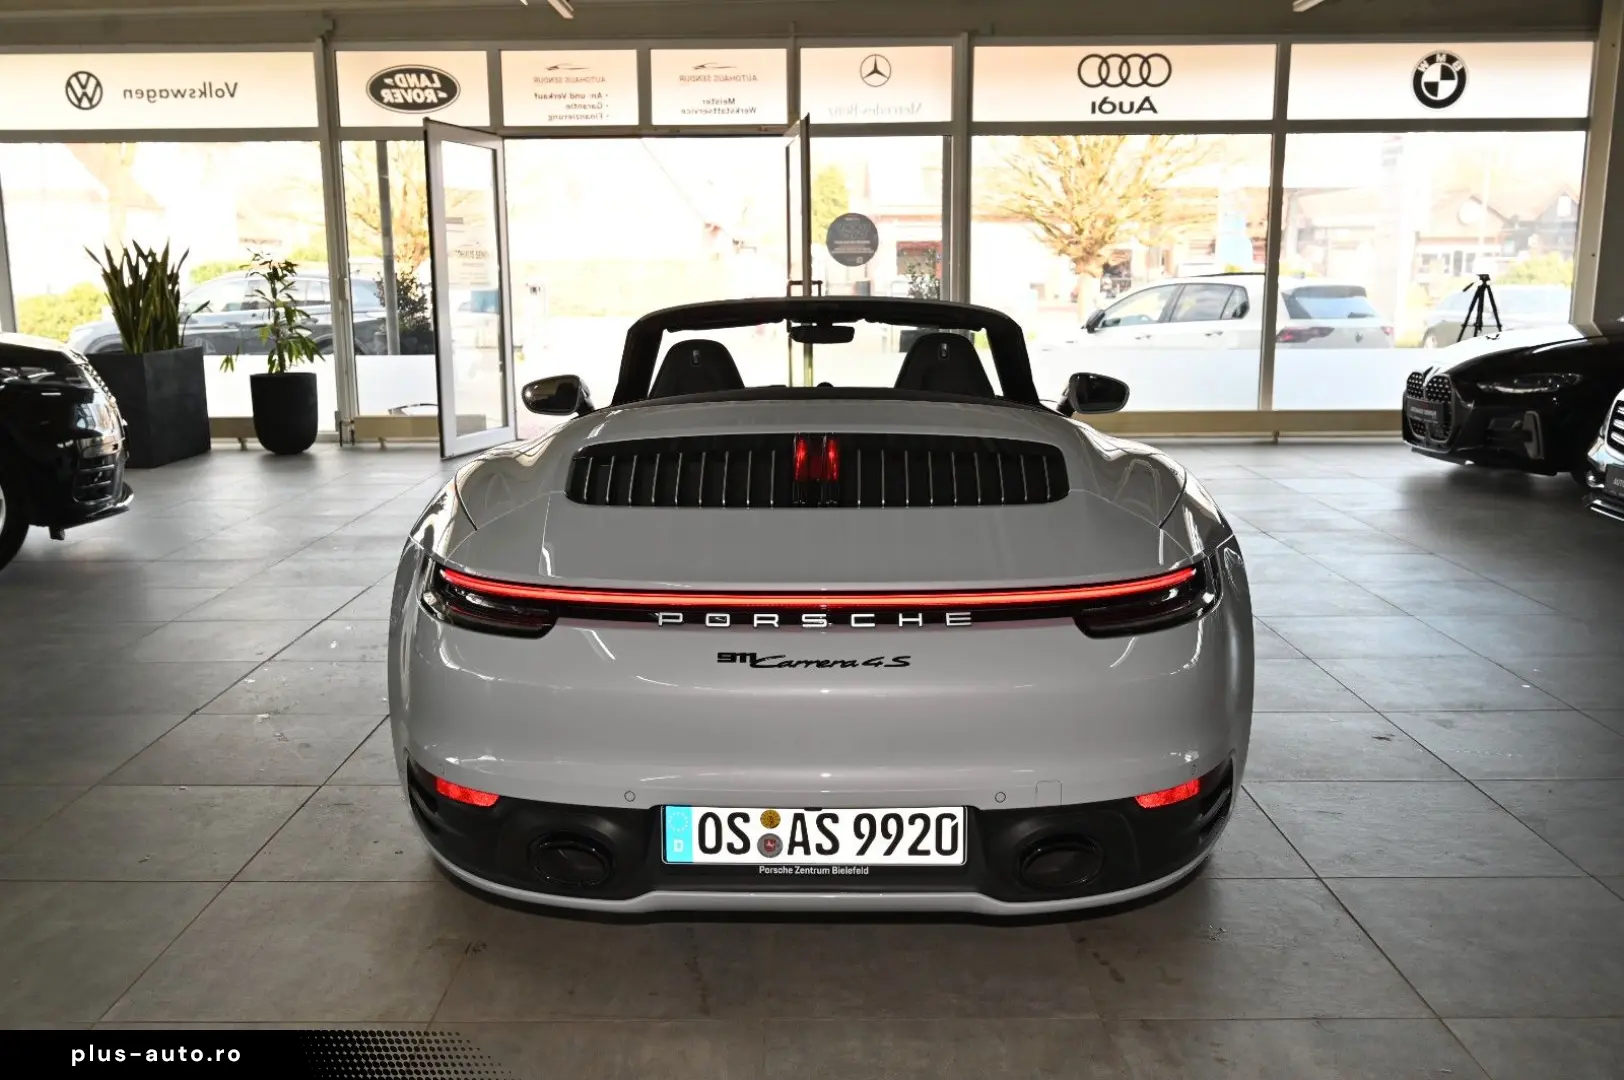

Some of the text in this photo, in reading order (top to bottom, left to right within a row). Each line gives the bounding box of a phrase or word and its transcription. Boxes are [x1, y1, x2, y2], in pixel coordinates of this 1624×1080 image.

[658, 612, 972, 628] PORSCHE
[750, 654, 860, 668] Carrera
[698, 811, 959, 856] OS AS 9920
[759, 865, 869, 875] Porsche Zentrum Bielefeld
